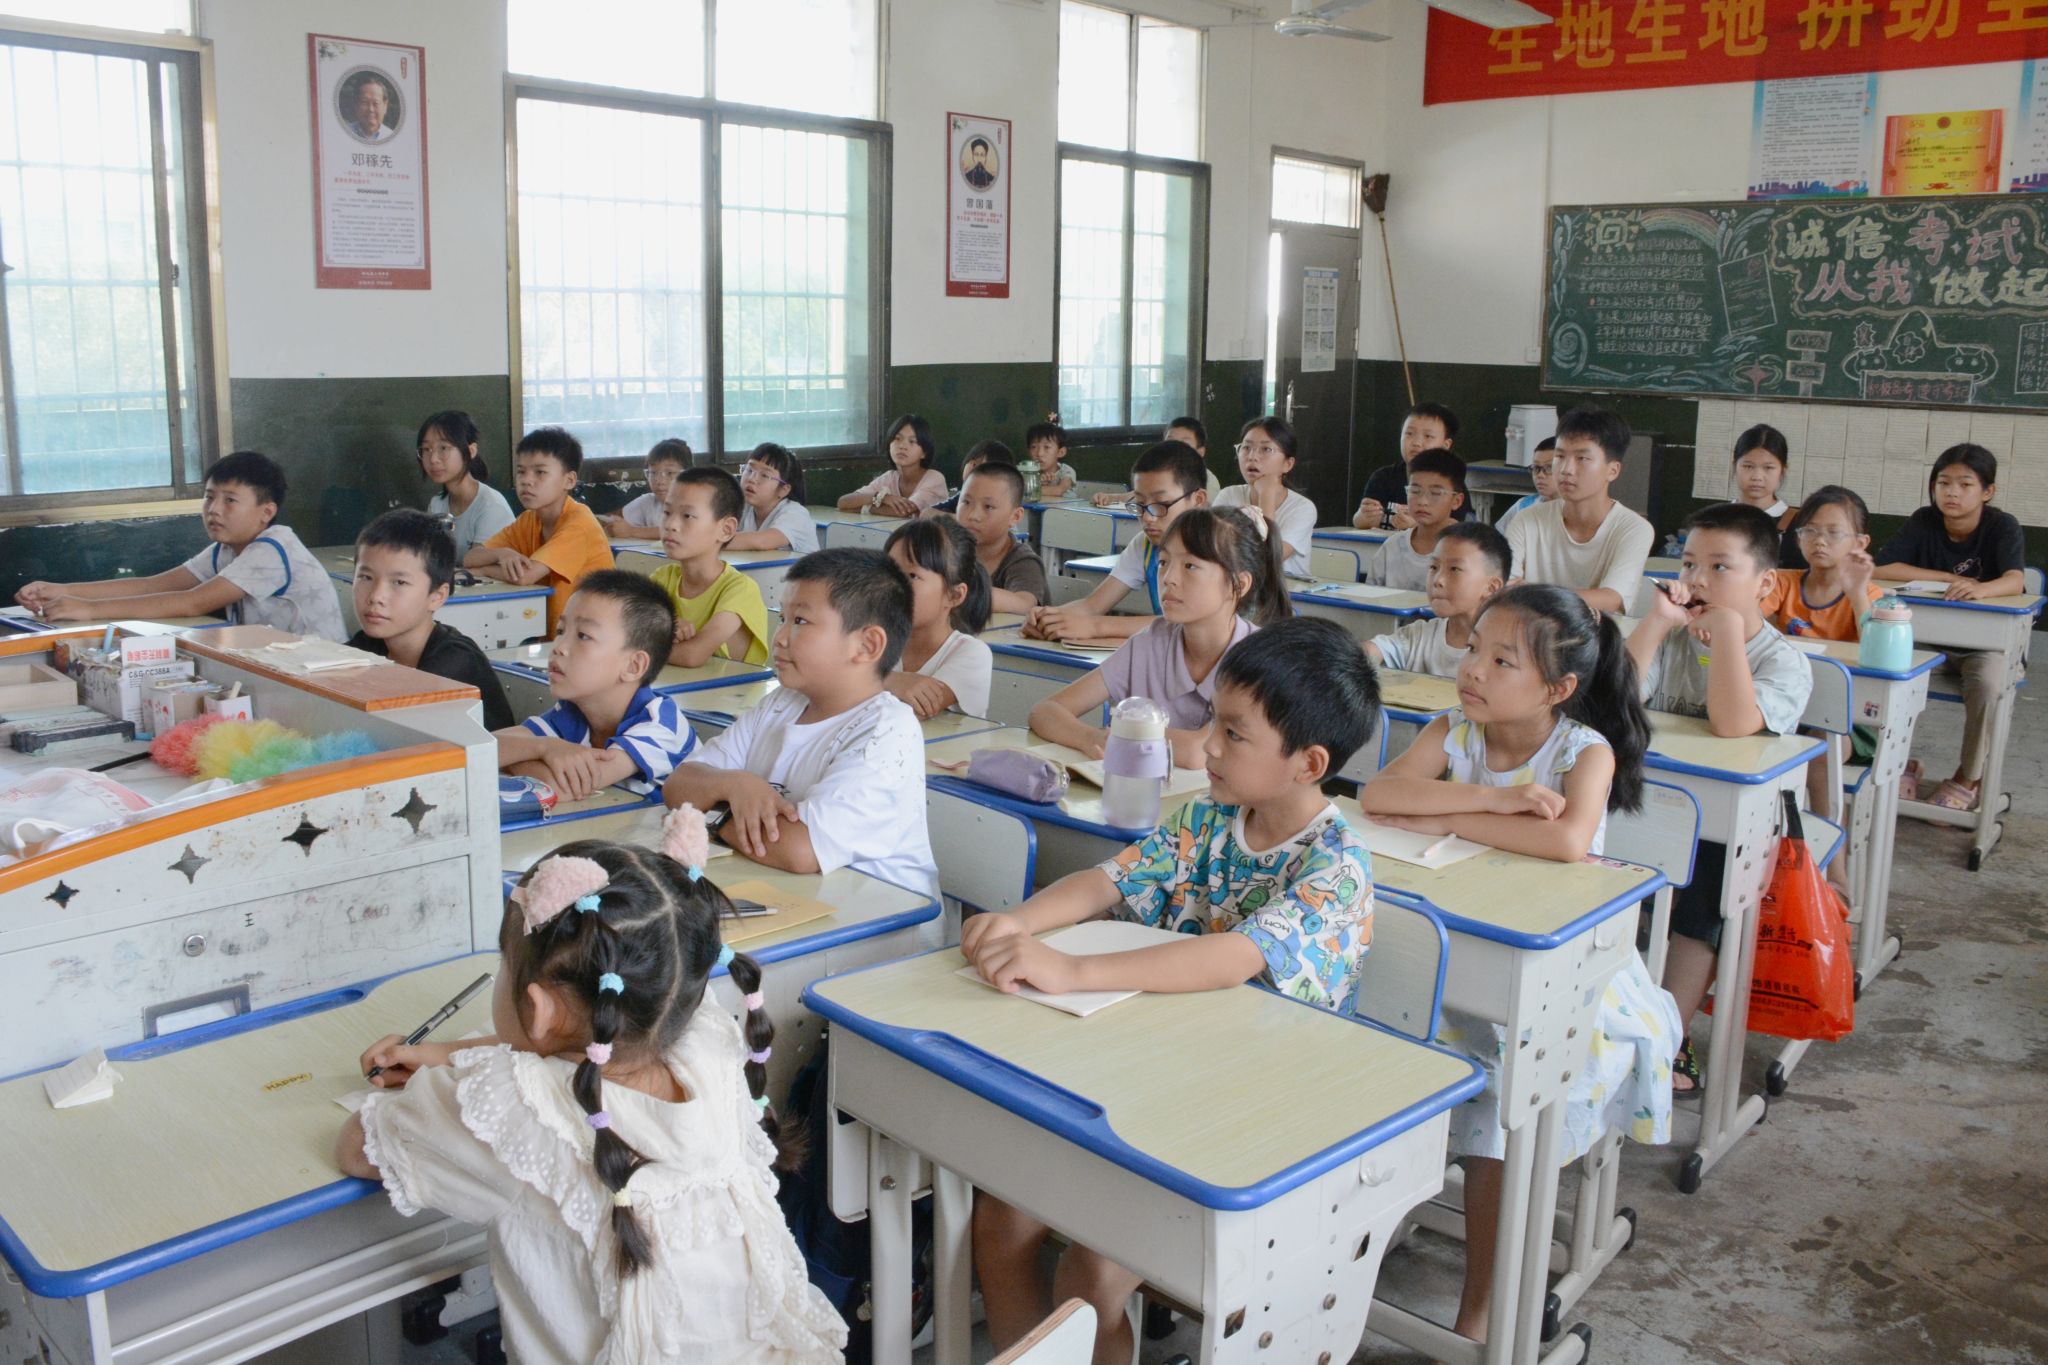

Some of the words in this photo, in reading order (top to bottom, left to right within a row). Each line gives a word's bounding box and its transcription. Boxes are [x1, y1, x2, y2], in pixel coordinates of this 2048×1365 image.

[351, 153, 393, 169] 邓稼先
[1786, 210, 2023, 266] 诚信考试
[1804, 257, 2048, 307] 从我做起
